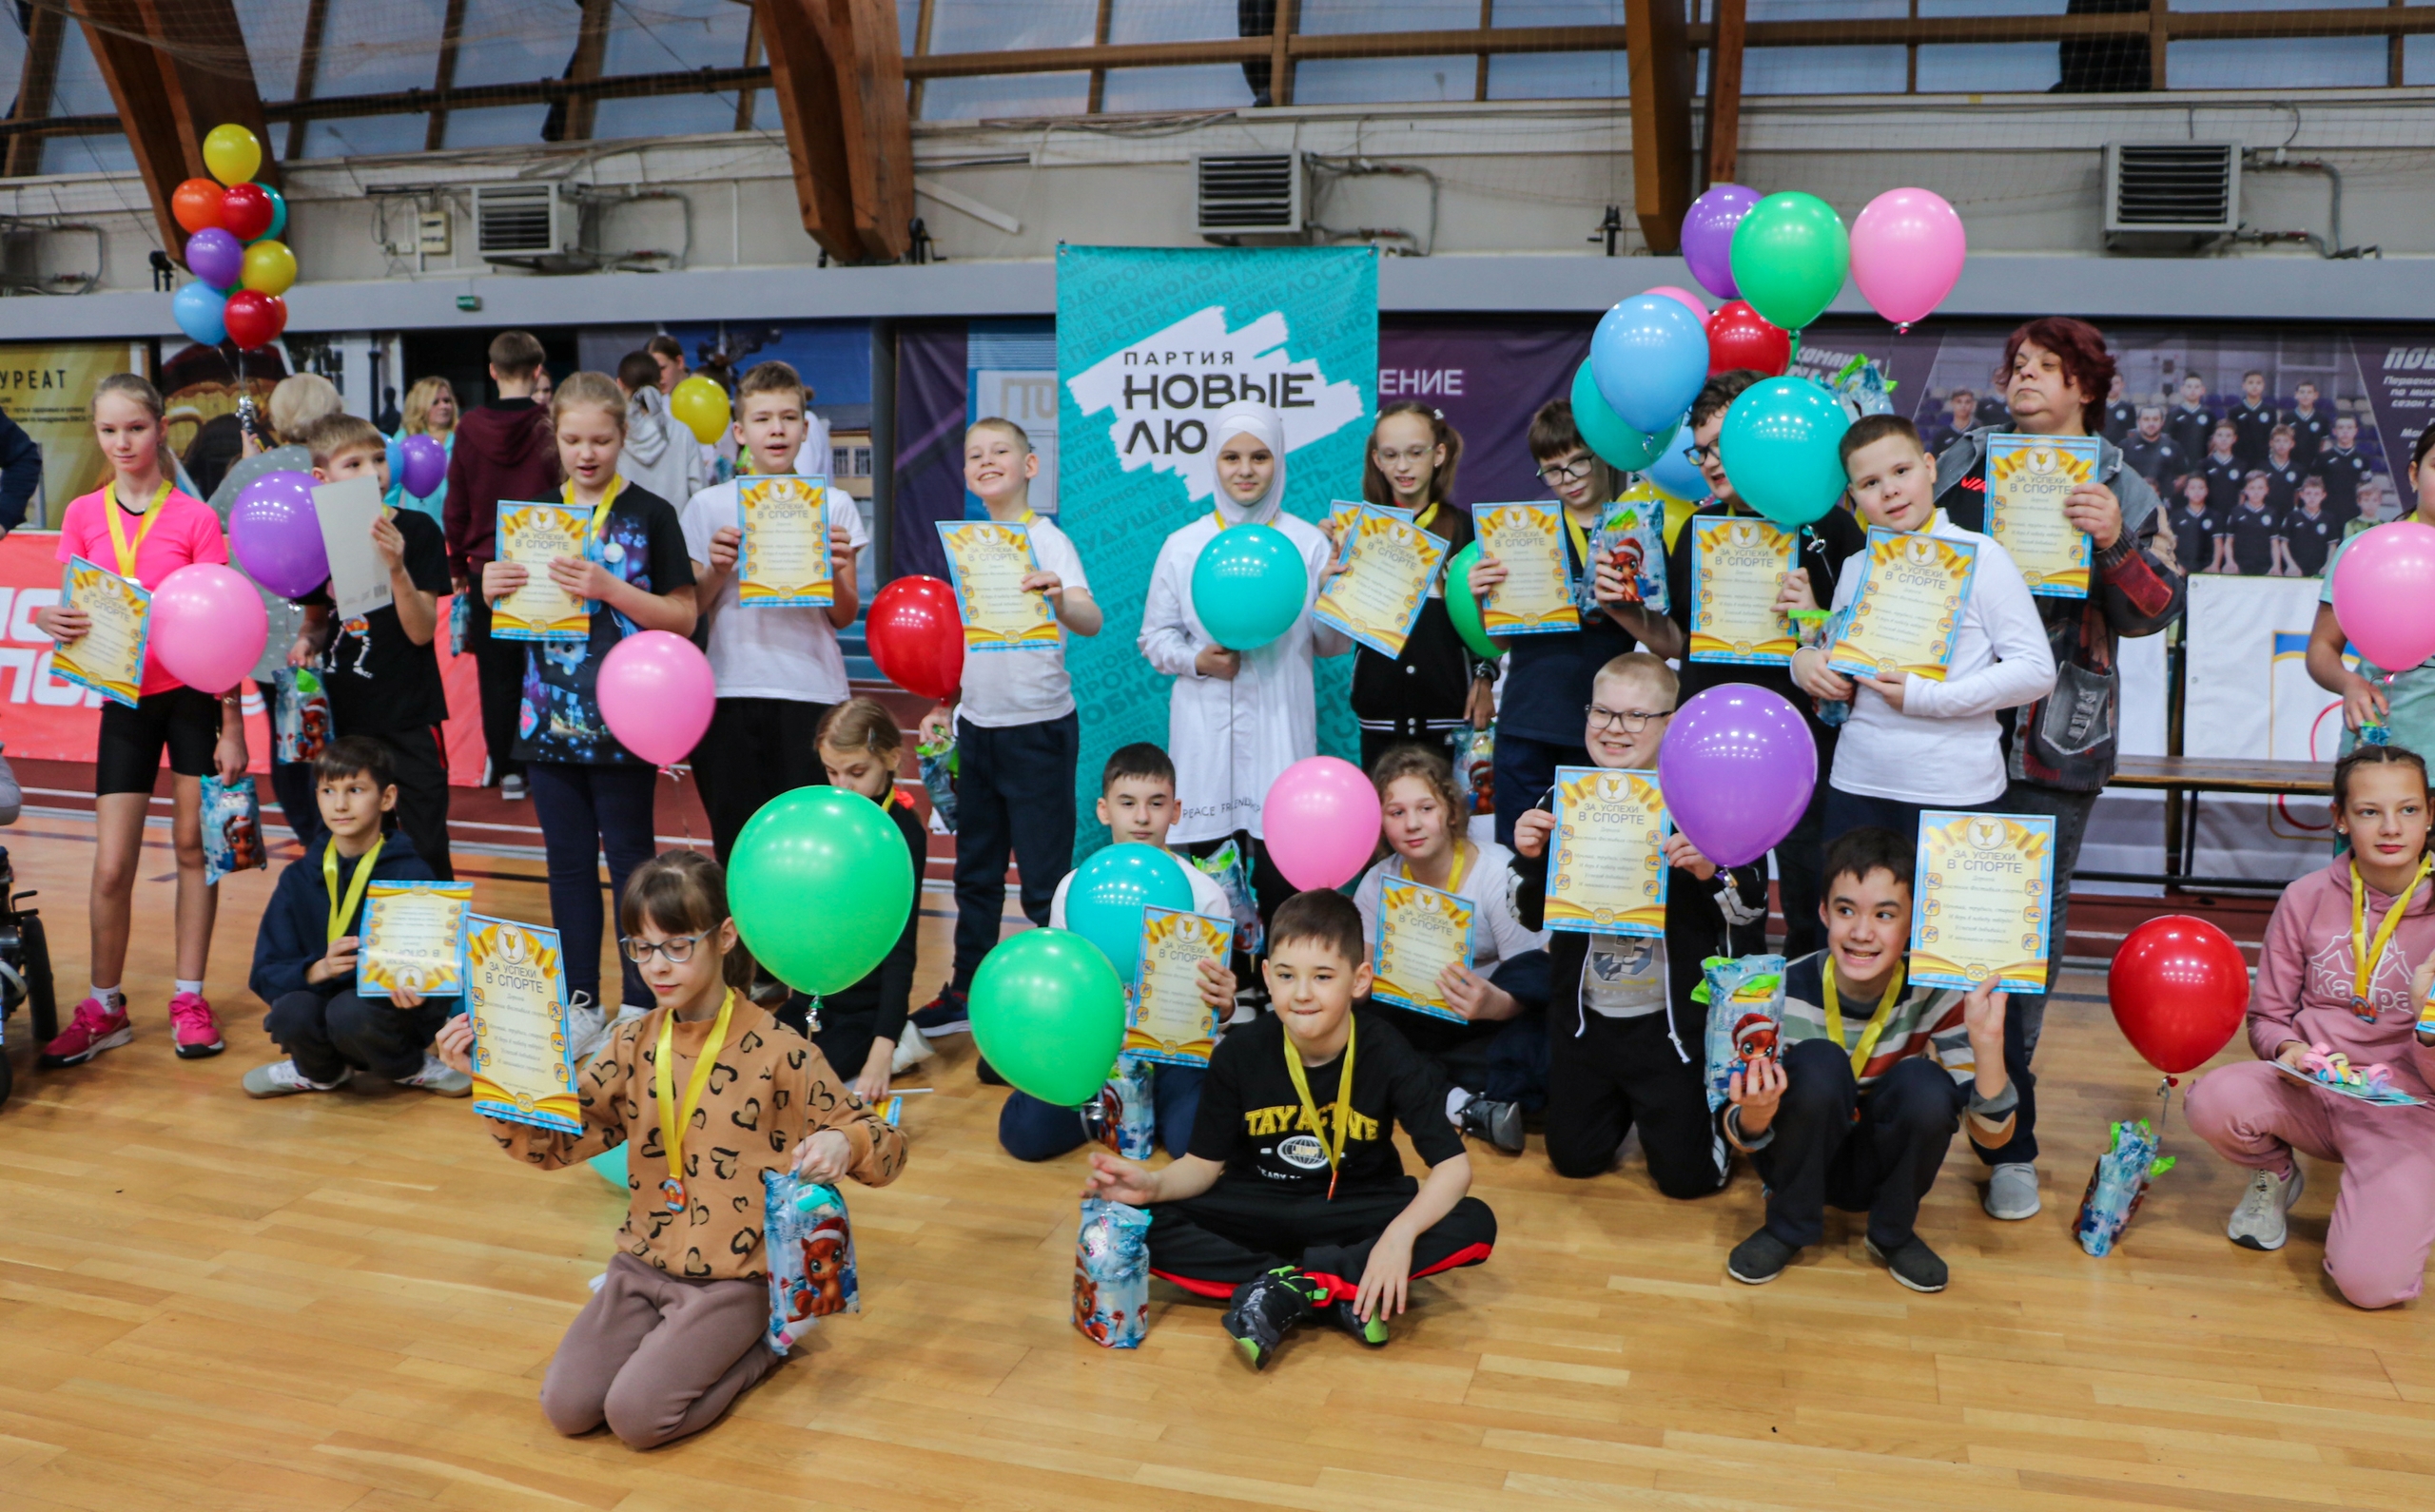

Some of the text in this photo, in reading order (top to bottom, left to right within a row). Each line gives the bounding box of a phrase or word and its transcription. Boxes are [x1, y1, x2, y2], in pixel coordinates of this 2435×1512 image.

[1124, 351, 1234, 365] ПАРТИЯ
[1379, 369, 1463, 396] ЕНИЕ
[1122, 373, 1315, 410] НОВЫЕ
[1124, 419, 1208, 455] ЛЮ
[2031, 475, 2067, 484] УСПЕХИ
[2010, 483, 2072, 494] В СПОРТЕ
[774, 502, 804, 511] УСПЕХИ
[757, 510, 808, 519] В СПОРТЕ
[533, 533, 564, 541] УСПЕХИ
[1494, 537, 1545, 548] В СПОРТЕ
[515, 539, 569, 551] В СПОРТЕ
[1734, 549, 1769, 557] УСПЕХИ
[1715, 556, 1774, 568] В СПОРТЕ
[1892, 563, 1943, 578] ЗА УСПЕХИ
[1885, 571, 1947, 590] В СПОРТЕ
[1080, 672, 1174, 726] ОБНО
[1182, 806, 1216, 818] PEACE
[1584, 803, 1639, 813] ЗА УСПЕХИ
[1578, 811, 1645, 825] В СПОРТЕ
[1953, 850, 2016, 861] ЗА УСПЕХИ
[1947, 859, 2023, 874] В СПОРТЕ
[488, 961, 536, 979] ЗА УСПЕХИ
[486, 971, 544, 994] В СПОРТЕ
[2312, 966, 2413, 1014] Kapa
[1245, 1105, 1297, 1135] TAY
[1292, 1144, 1319, 1156] JUMP
[1256, 1165, 1286, 1179] EADY
